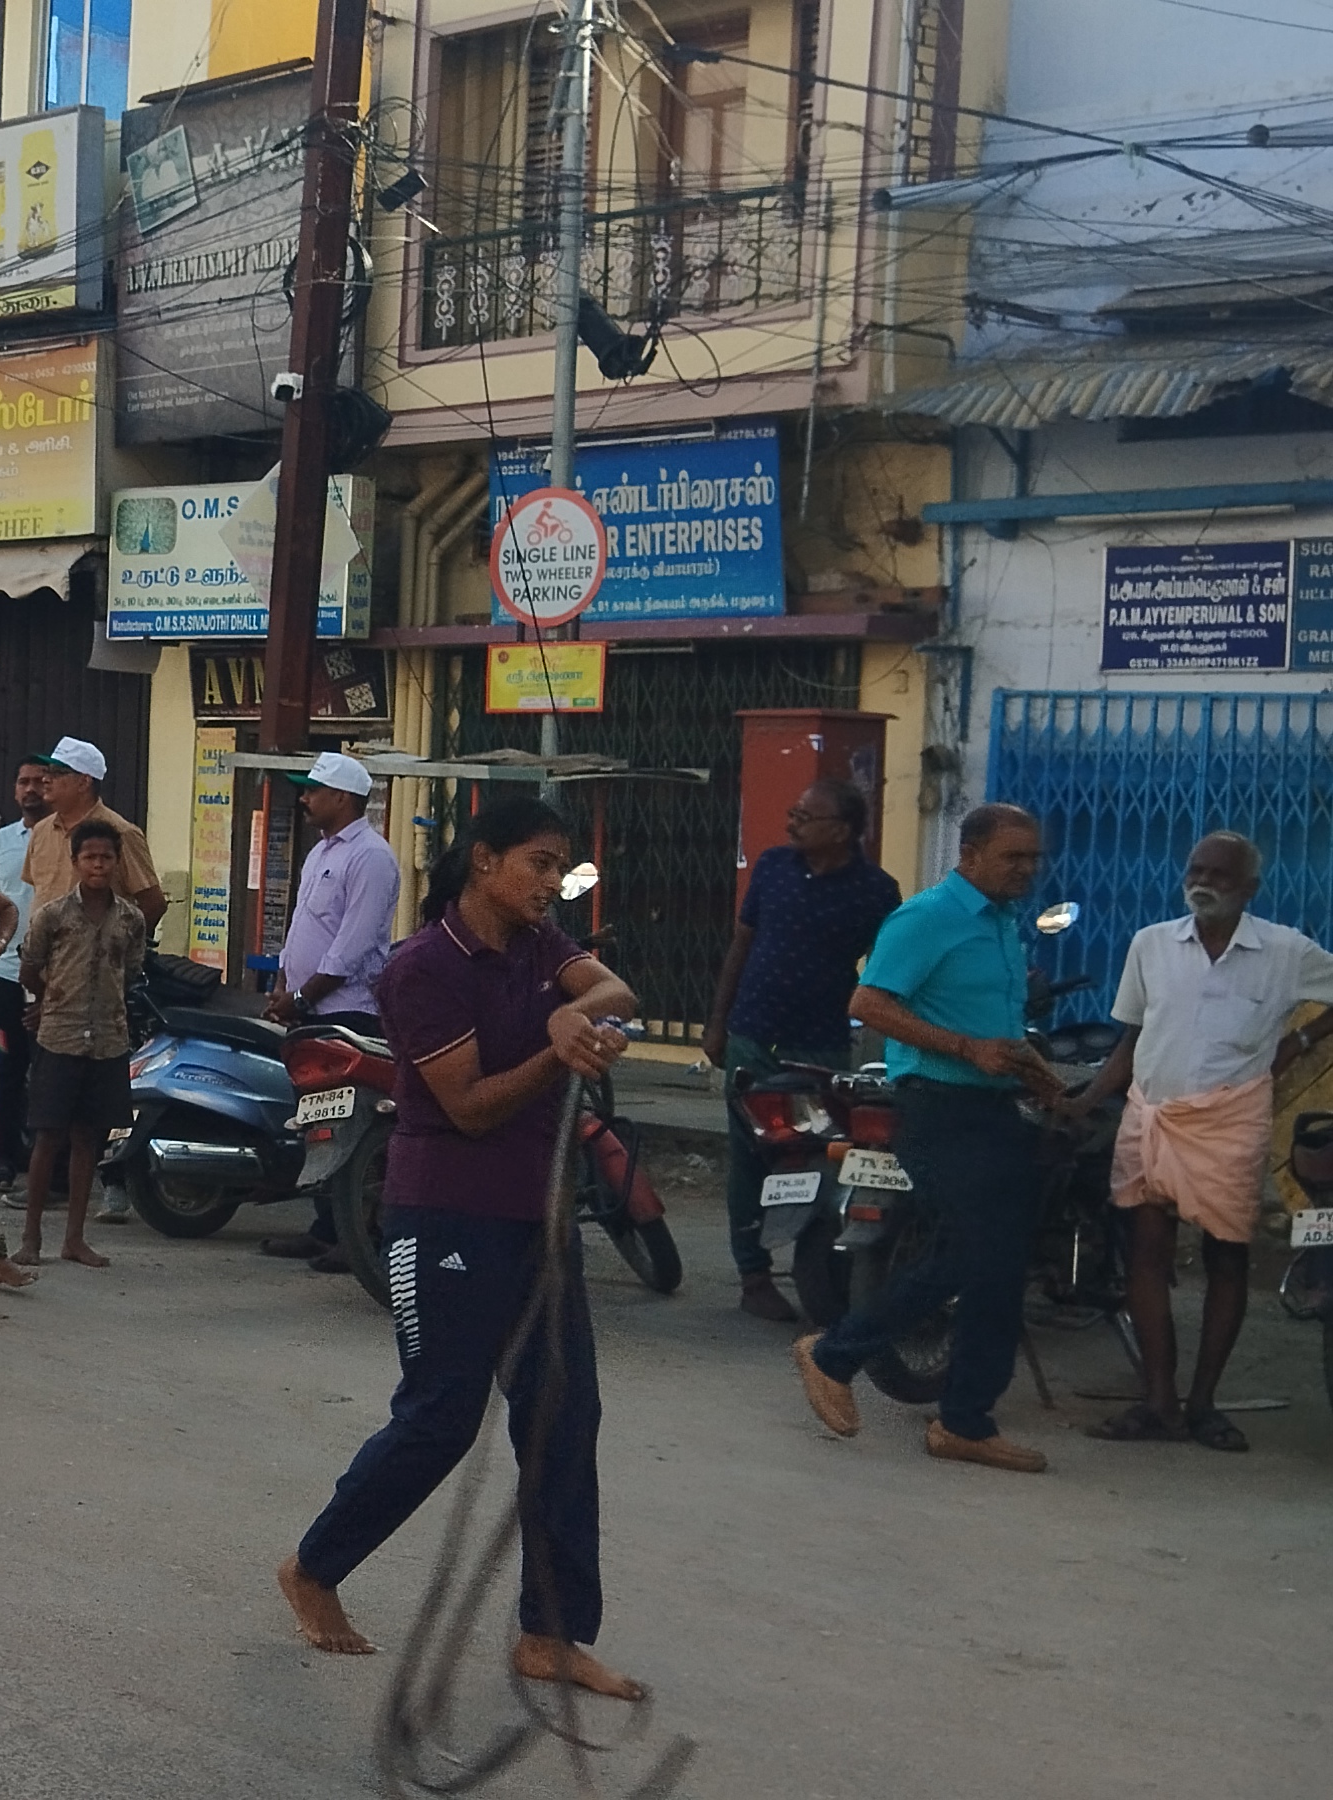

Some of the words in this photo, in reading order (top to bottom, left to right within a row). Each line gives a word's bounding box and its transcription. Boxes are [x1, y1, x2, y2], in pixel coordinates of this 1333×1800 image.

[8, 442, 20, 456] &
[625, 517, 763, 558] ENTERPRISES
[502, 546, 557, 565] SINGLE
[563, 544, 597, 561] LINE
[121, 564, 181, 589] உருட்டு
[505, 570, 533, 583] TWO
[537, 567, 593, 582] WHEELER
[1252, 574, 1260, 595] &
[1263, 572, 1286, 595] சன்
[513, 585, 583, 604] PARKING
[112, 619, 154, 632] Manufacturers:
[155, 615, 229, 632] O.M.S.R.SIVAJOTHI
[231, 614, 258, 630] DHALL
[1109, 605, 1243, 626] P.A.M.AYYEMPERUMAL
[1246, 605, 1255, 624] &
[1259, 604, 1286, 623] SON
[1297, 630, 1333, 643] GRA
[1129, 657, 1159, 669] GSTIN
[1308, 650, 1333, 663] ME
[308, 1090, 344, 1106] TN-84
[301, 1105, 346, 1122] X-9815
